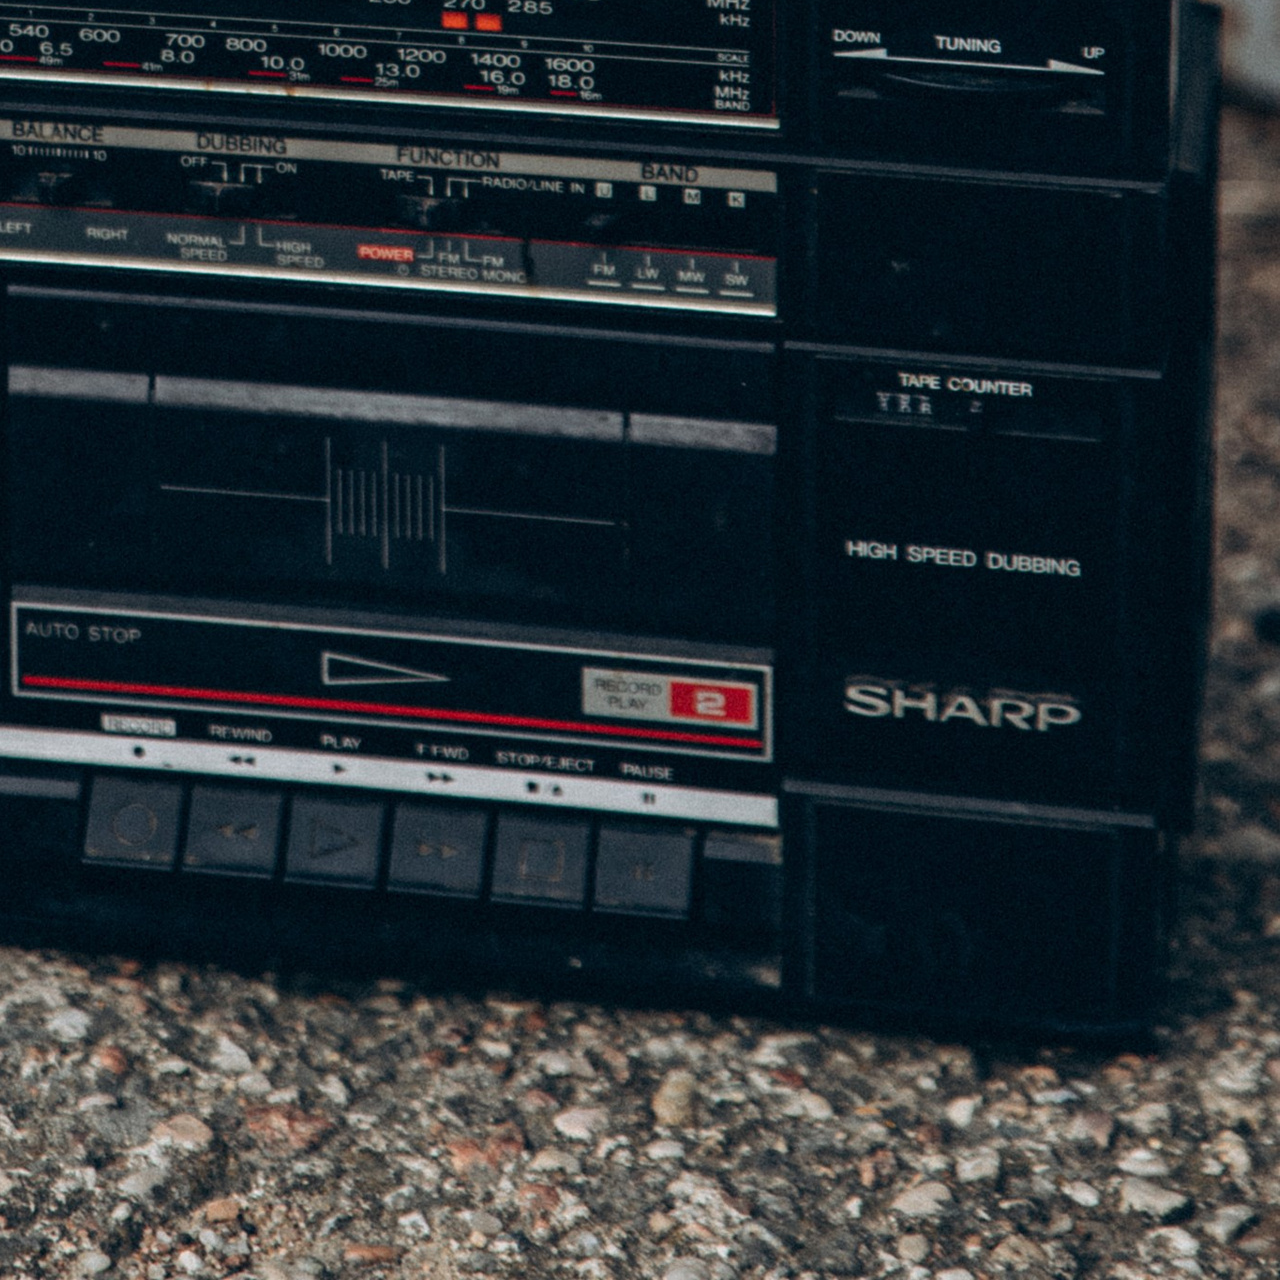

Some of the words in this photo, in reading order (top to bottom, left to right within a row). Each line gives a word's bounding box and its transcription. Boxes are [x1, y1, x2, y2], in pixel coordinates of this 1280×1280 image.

[507, 0, 553, 16] 285
[719, 13, 751, 27] kHz
[833, 29, 881, 44] DOWN
[935, 34, 1002, 53] TUNING
[9, 23, 49, 39] 540
[79, 29, 120, 44] 600
[166, 33, 205, 49] 700
[226, 37, 267, 54] 800
[318, 43, 367, 59] 1000
[396, 47, 447, 64] 1200
[471, 52, 521, 68] 1400
[545, 57, 595, 73] 1600
[719, 69, 751, 84] kHz
[583, 44, 595, 52] 10
[717, 53, 750, 63] SCALE
[1083, 46, 1106, 59] UP
[39, 42, 73, 57] 6.5
[160, 50, 195, 65] 8.0
[261, 55, 306, 72] 10.0
[375, 63, 421, 79] 13.0
[480, 69, 526, 85] 16.0
[548, 74, 595, 90] 18.0
[714, 85, 751, 100] MHz
[39, 56, 64, 67] 49m
[142, 62, 164, 72] 41m
[289, 72, 311, 82] 31m
[375, 77, 399, 88] 25m
[497, 84, 520, 96] 19m
[580, 90, 603, 101] 16m
[714, 99, 751, 111] BAND
[13, 122, 104, 142] BALANCE
[197, 133, 287, 154] DUBBING
[13, 146, 26, 157] 10
[93, 150, 107, 162] 10
[181, 156, 208, 168] OFF
[396, 146, 500, 169] FUNCTION
[276, 162, 297, 174] ON
[380, 169, 414, 182] TAPE
[641, 164, 698, 183] BAND
[482, 175, 564, 193] RADIO/LINE
[570, 181, 585, 194] IN
[87, 227, 129, 240] RIGHT
[167, 233, 225, 248] NORMAL
[181, 247, 228, 262] SPEED
[276, 241, 311, 254] HIGH
[359, 246, 414, 260] POWER
[277, 254, 325, 268] SPEED
[439, 251, 460, 264] FM
[483, 255, 504, 268] FM
[421, 264, 478, 279] STEREO
[594, 262, 616, 275] FM
[637, 266, 659, 279] LW
[678, 269, 706, 282] MW
[725, 272, 748, 285] SW
[899, 372, 941, 390] TAPE
[948, 377, 1033, 397] COUNTER
[846, 539, 897, 560] HIGH
[905, 544, 976, 566] SPEED
[985, 551, 1081, 576] DUBBING
[25, 622, 80, 640] AUTO
[88, 626, 143, 644] STOP
[594, 677, 662, 695] RECORD
[608, 694, 648, 710] PLAY
[695, 691, 727, 716] 2
[843, 683, 1082, 731] SHARP
[208, 724, 273, 743] REWIND
[321, 734, 362, 750] PLAY
[496, 750, 595, 771] STOP/EJECT
[620, 762, 674, 780] PAUSE
